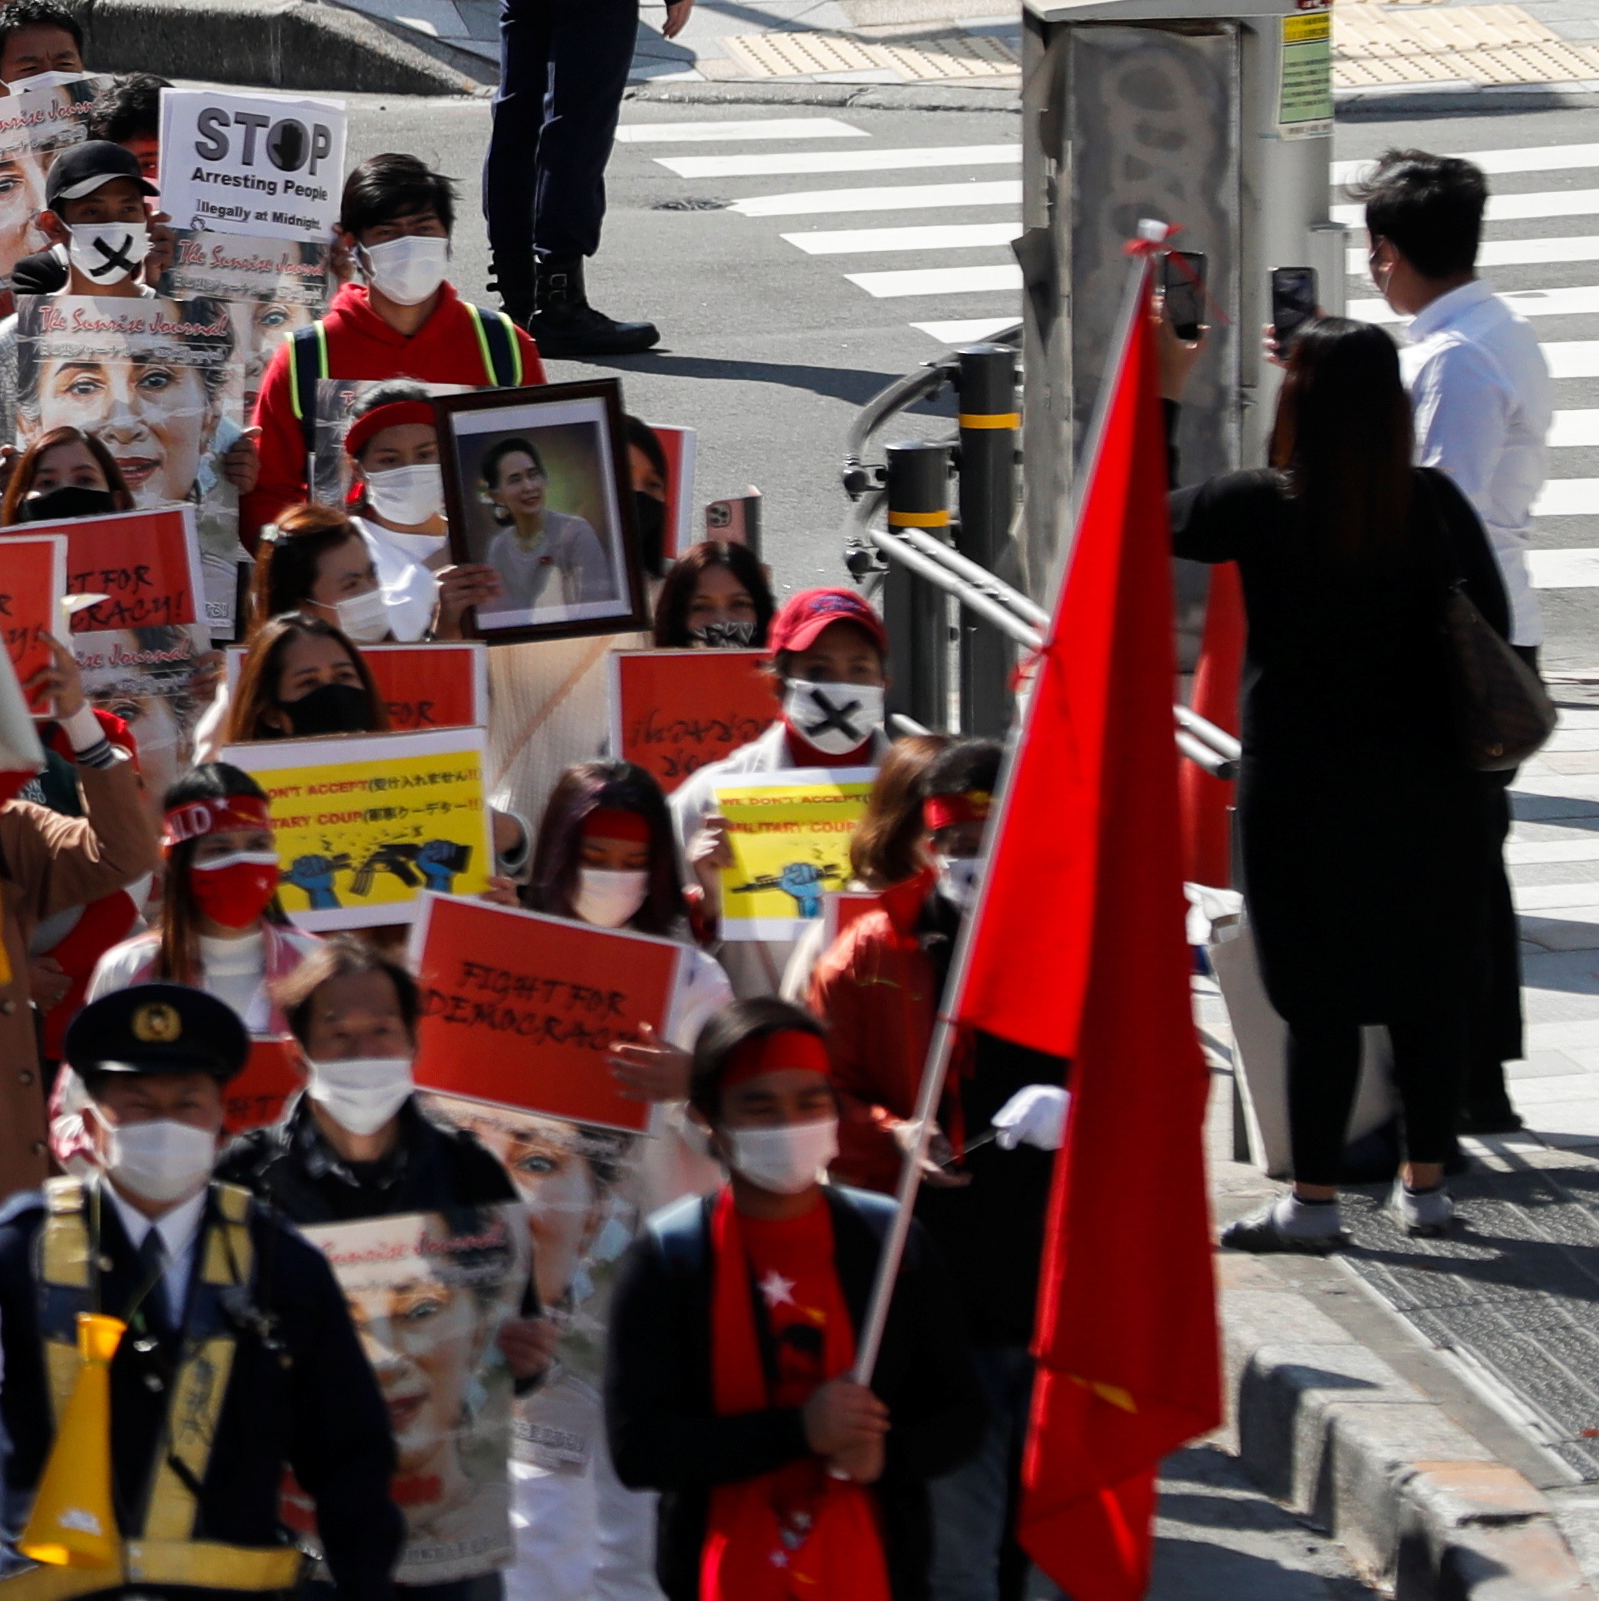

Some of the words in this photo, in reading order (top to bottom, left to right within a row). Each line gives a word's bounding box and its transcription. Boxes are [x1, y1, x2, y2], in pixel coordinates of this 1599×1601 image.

[194, 106, 333, 177] STOP
[191, 166, 278, 195] Arresting
[283, 178, 328, 202] People
[196, 199, 252, 221] Illegally
[255, 209, 268, 220] at
[178, 240, 204, 264] The
[210, 245, 272, 271] Sunrise
[38, 306, 65, 331] The
[70, 308, 145, 333] Sunrise
[147, 312, 230, 337] Journal
[100, 563, 154, 597] FOR
[105, 638, 192, 666] Journal
[458, 961, 568, 1001] FIGHT
[564, 983, 627, 1020] FOR
